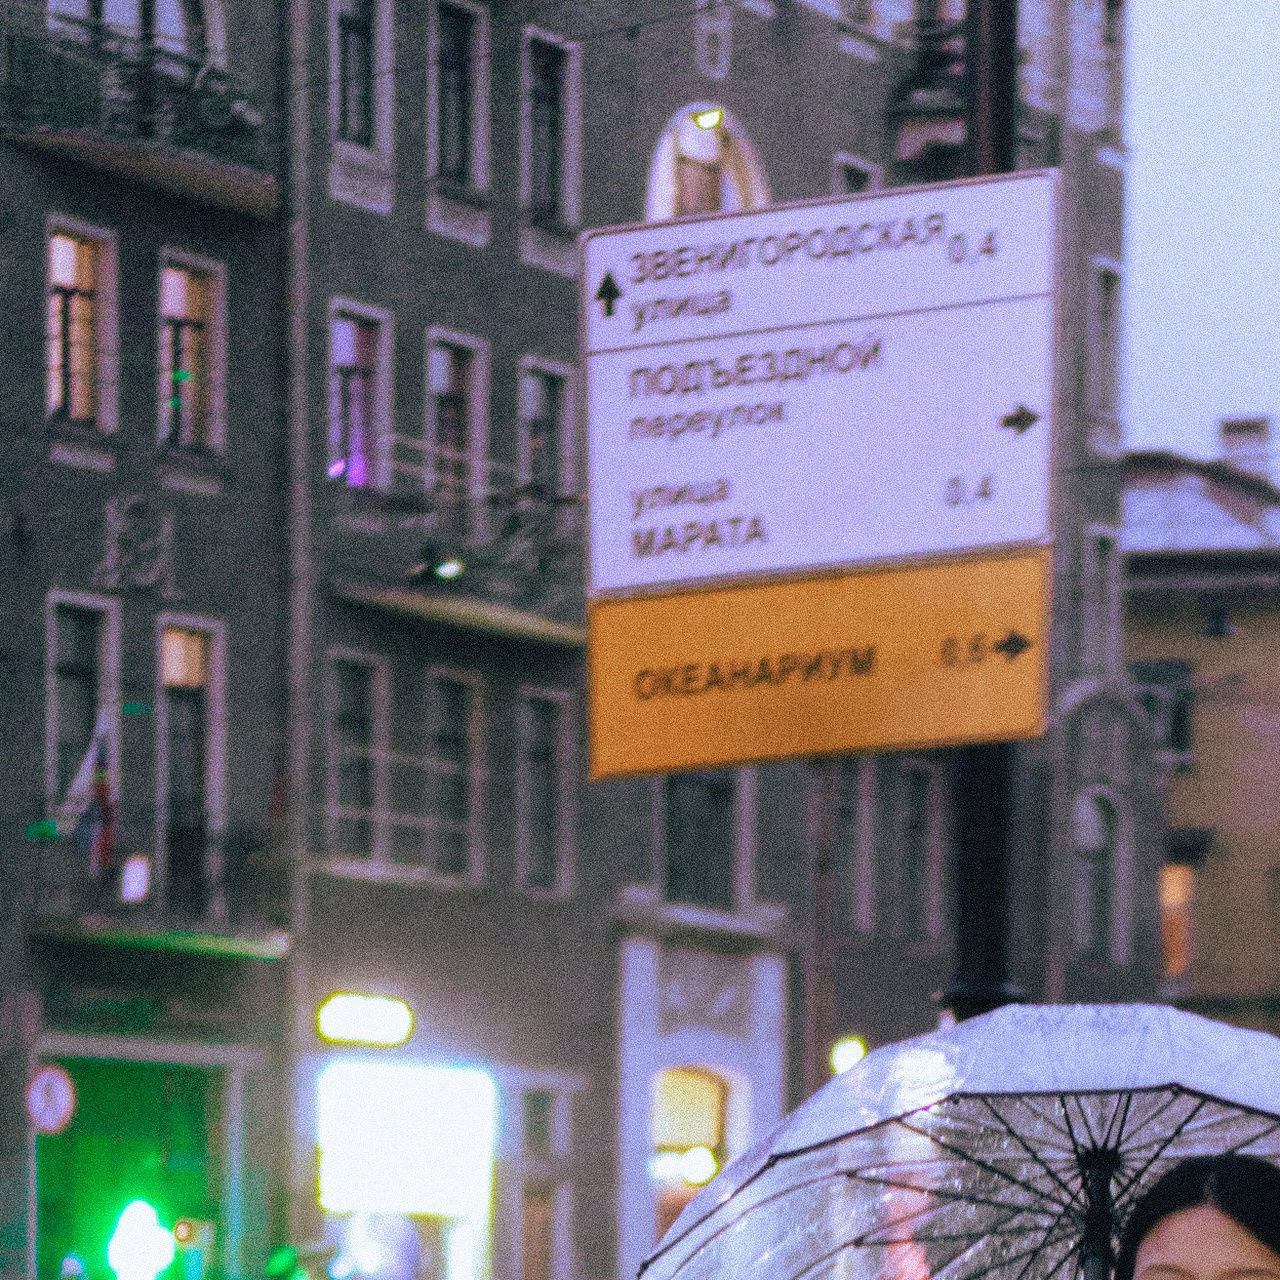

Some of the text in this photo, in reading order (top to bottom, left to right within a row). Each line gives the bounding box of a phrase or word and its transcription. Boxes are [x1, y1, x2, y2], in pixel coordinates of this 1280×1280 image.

[630, 214, 946, 284] ЗВЕНИГОРОДСКАЯ
[630, 290, 731, 331] улица
[629, 333, 883, 398] ПОДЪЕЗДНОЙ
[628, 401, 785, 442] переулок
[630, 478, 730, 520] улица
[632, 516, 767, 559] МАРАТА
[634, 645, 877, 701] ОКЕАНАРИУМ
